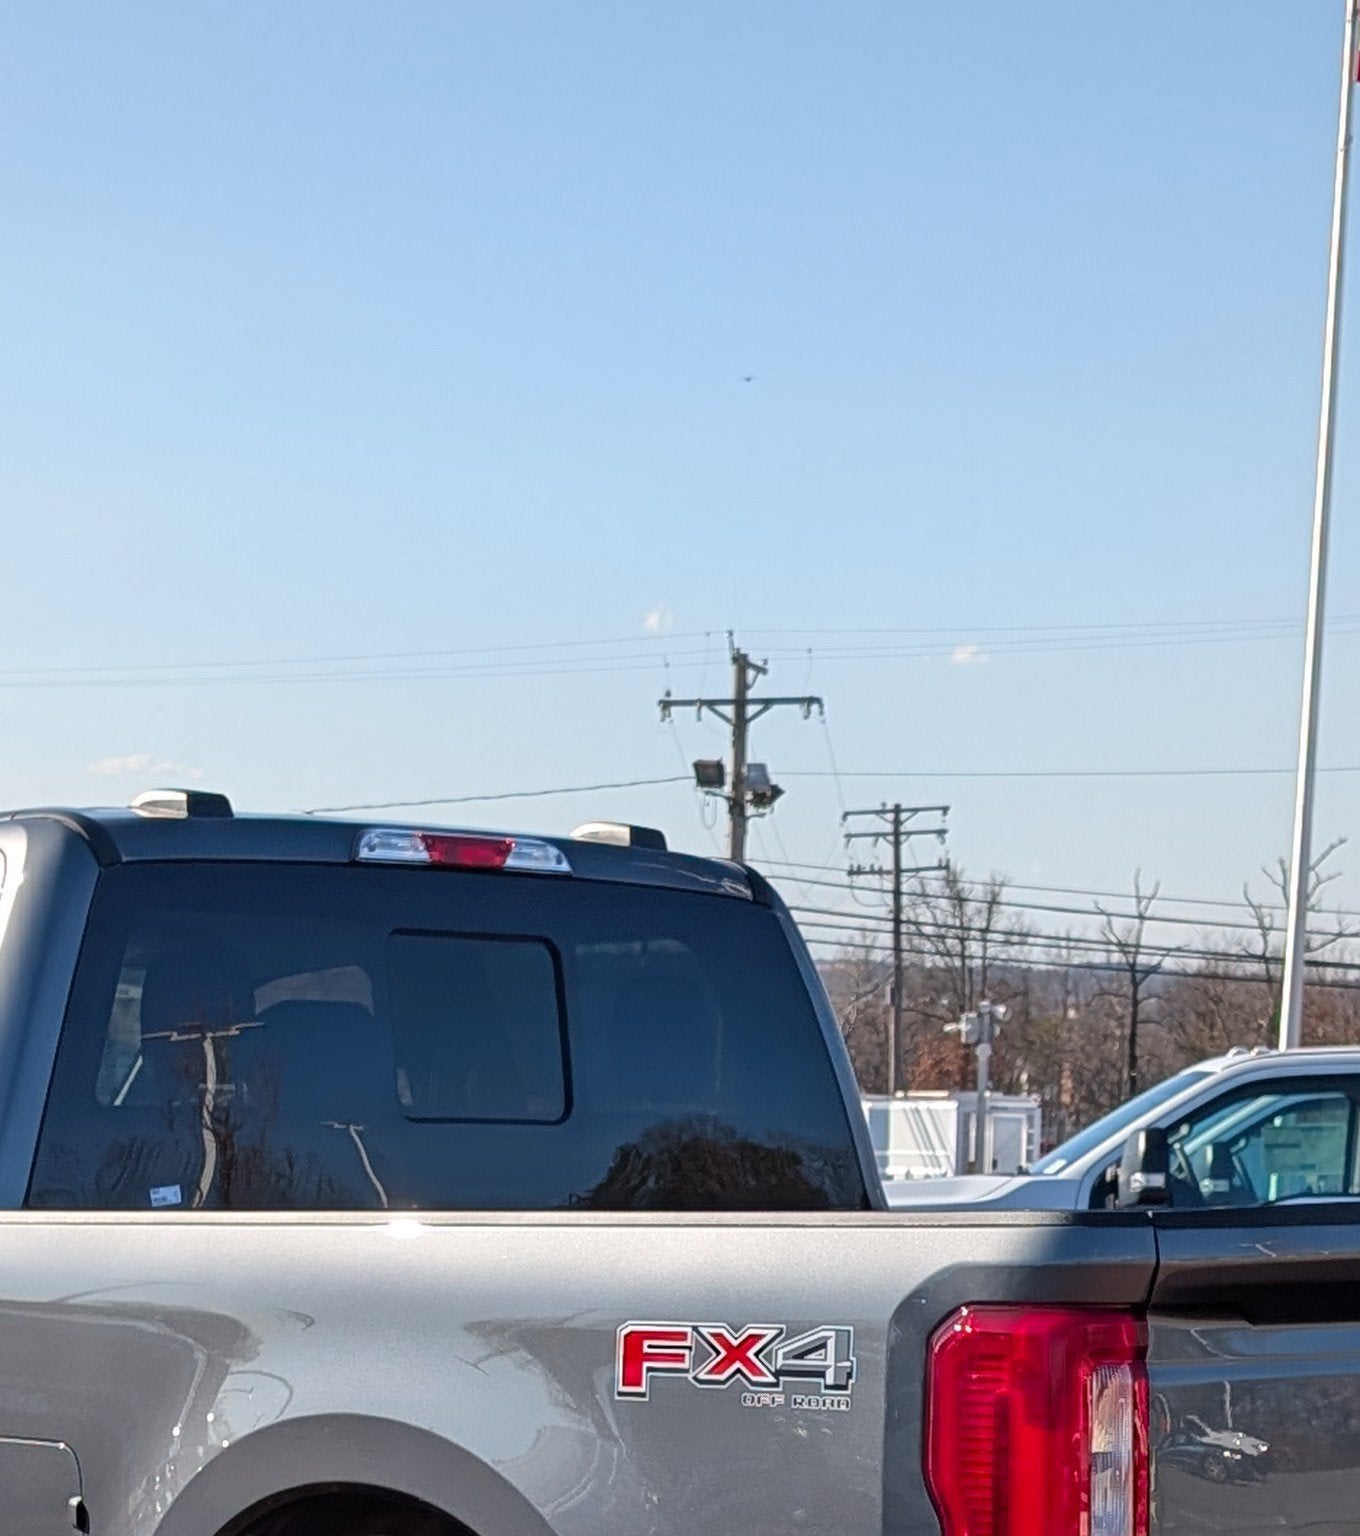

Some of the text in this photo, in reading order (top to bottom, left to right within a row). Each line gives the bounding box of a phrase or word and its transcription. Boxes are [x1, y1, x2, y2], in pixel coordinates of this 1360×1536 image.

[615, 1320, 857, 1401] FX4
[740, 1392, 852, 1412] OFF ROAD
